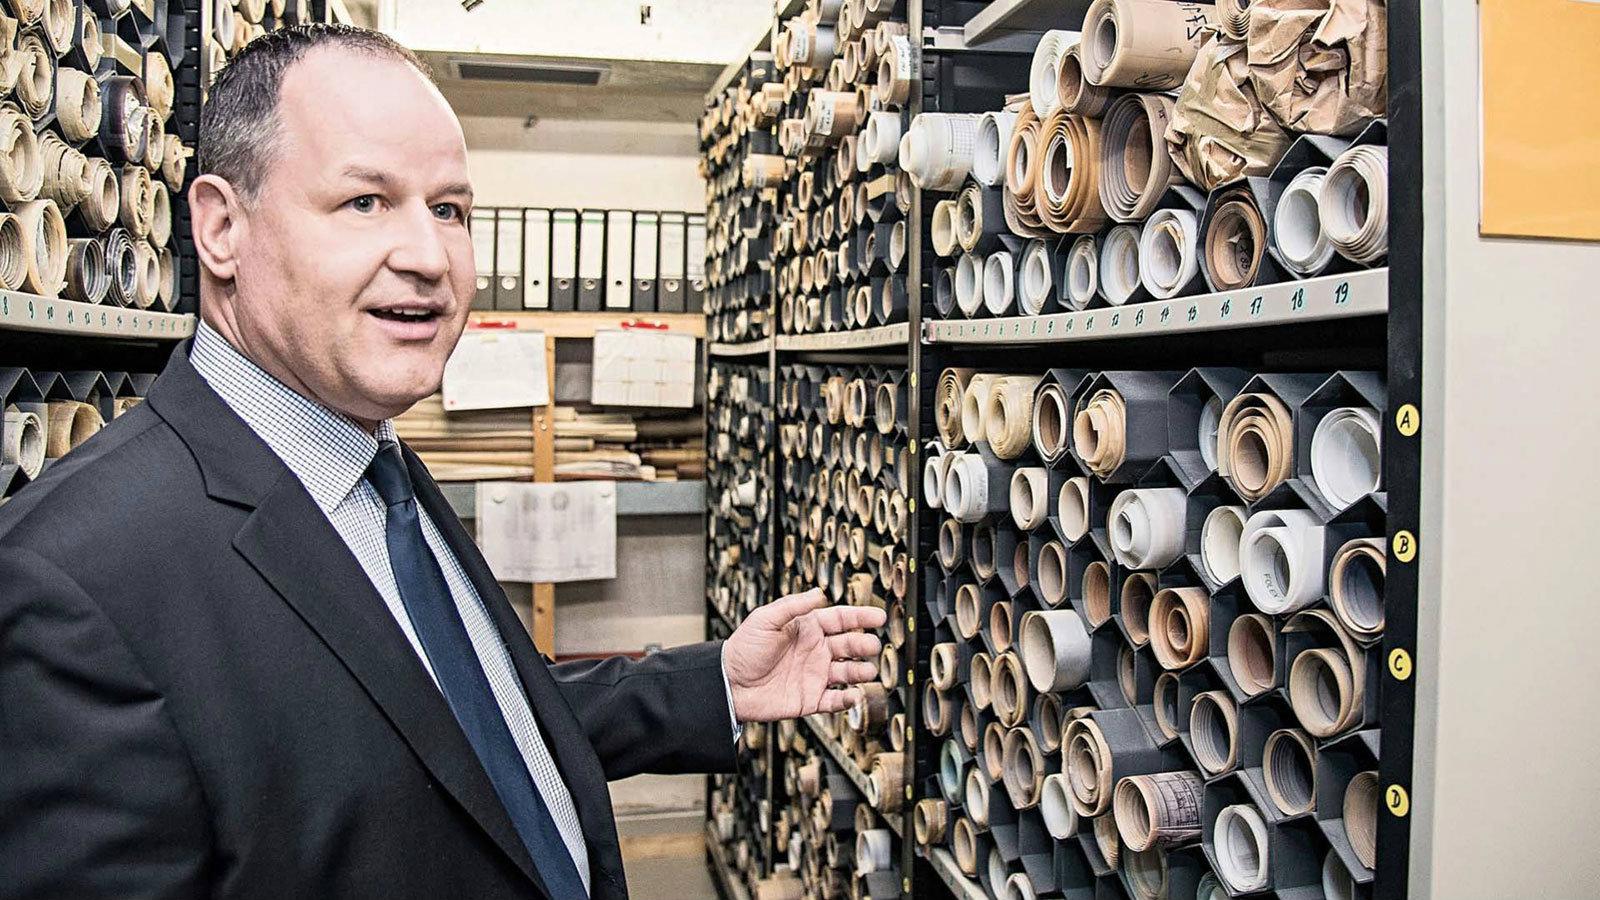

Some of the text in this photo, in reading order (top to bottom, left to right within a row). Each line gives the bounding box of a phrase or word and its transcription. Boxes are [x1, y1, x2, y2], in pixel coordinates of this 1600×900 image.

[3, 295, 9, 316] 8
[28, 300, 34, 319] 9
[47, 305, 54, 320] 10
[67, 309, 74, 324] 11
[1047, 320, 1054, 334] 9
[1065, 317, 1074, 331] 10
[1086, 316, 1094, 329] 11
[1110, 313, 1119, 327] 12
[1134, 308, 1144, 327] 13
[1160, 306, 1170, 322] 14
[1187, 305, 1197, 322] 15
[1220, 299, 1230, 318] 16
[1250, 296, 1263, 315] 17
[1291, 288, 1304, 311] 18
[1334, 281, 1349, 304] 19
[1400, 410, 1410, 428] A
[1398, 535, 1409, 555] B
[1263, 573, 1281, 598] FOLEX
[1395, 654, 1403, 672] C
[1391, 789, 1401, 808] D
